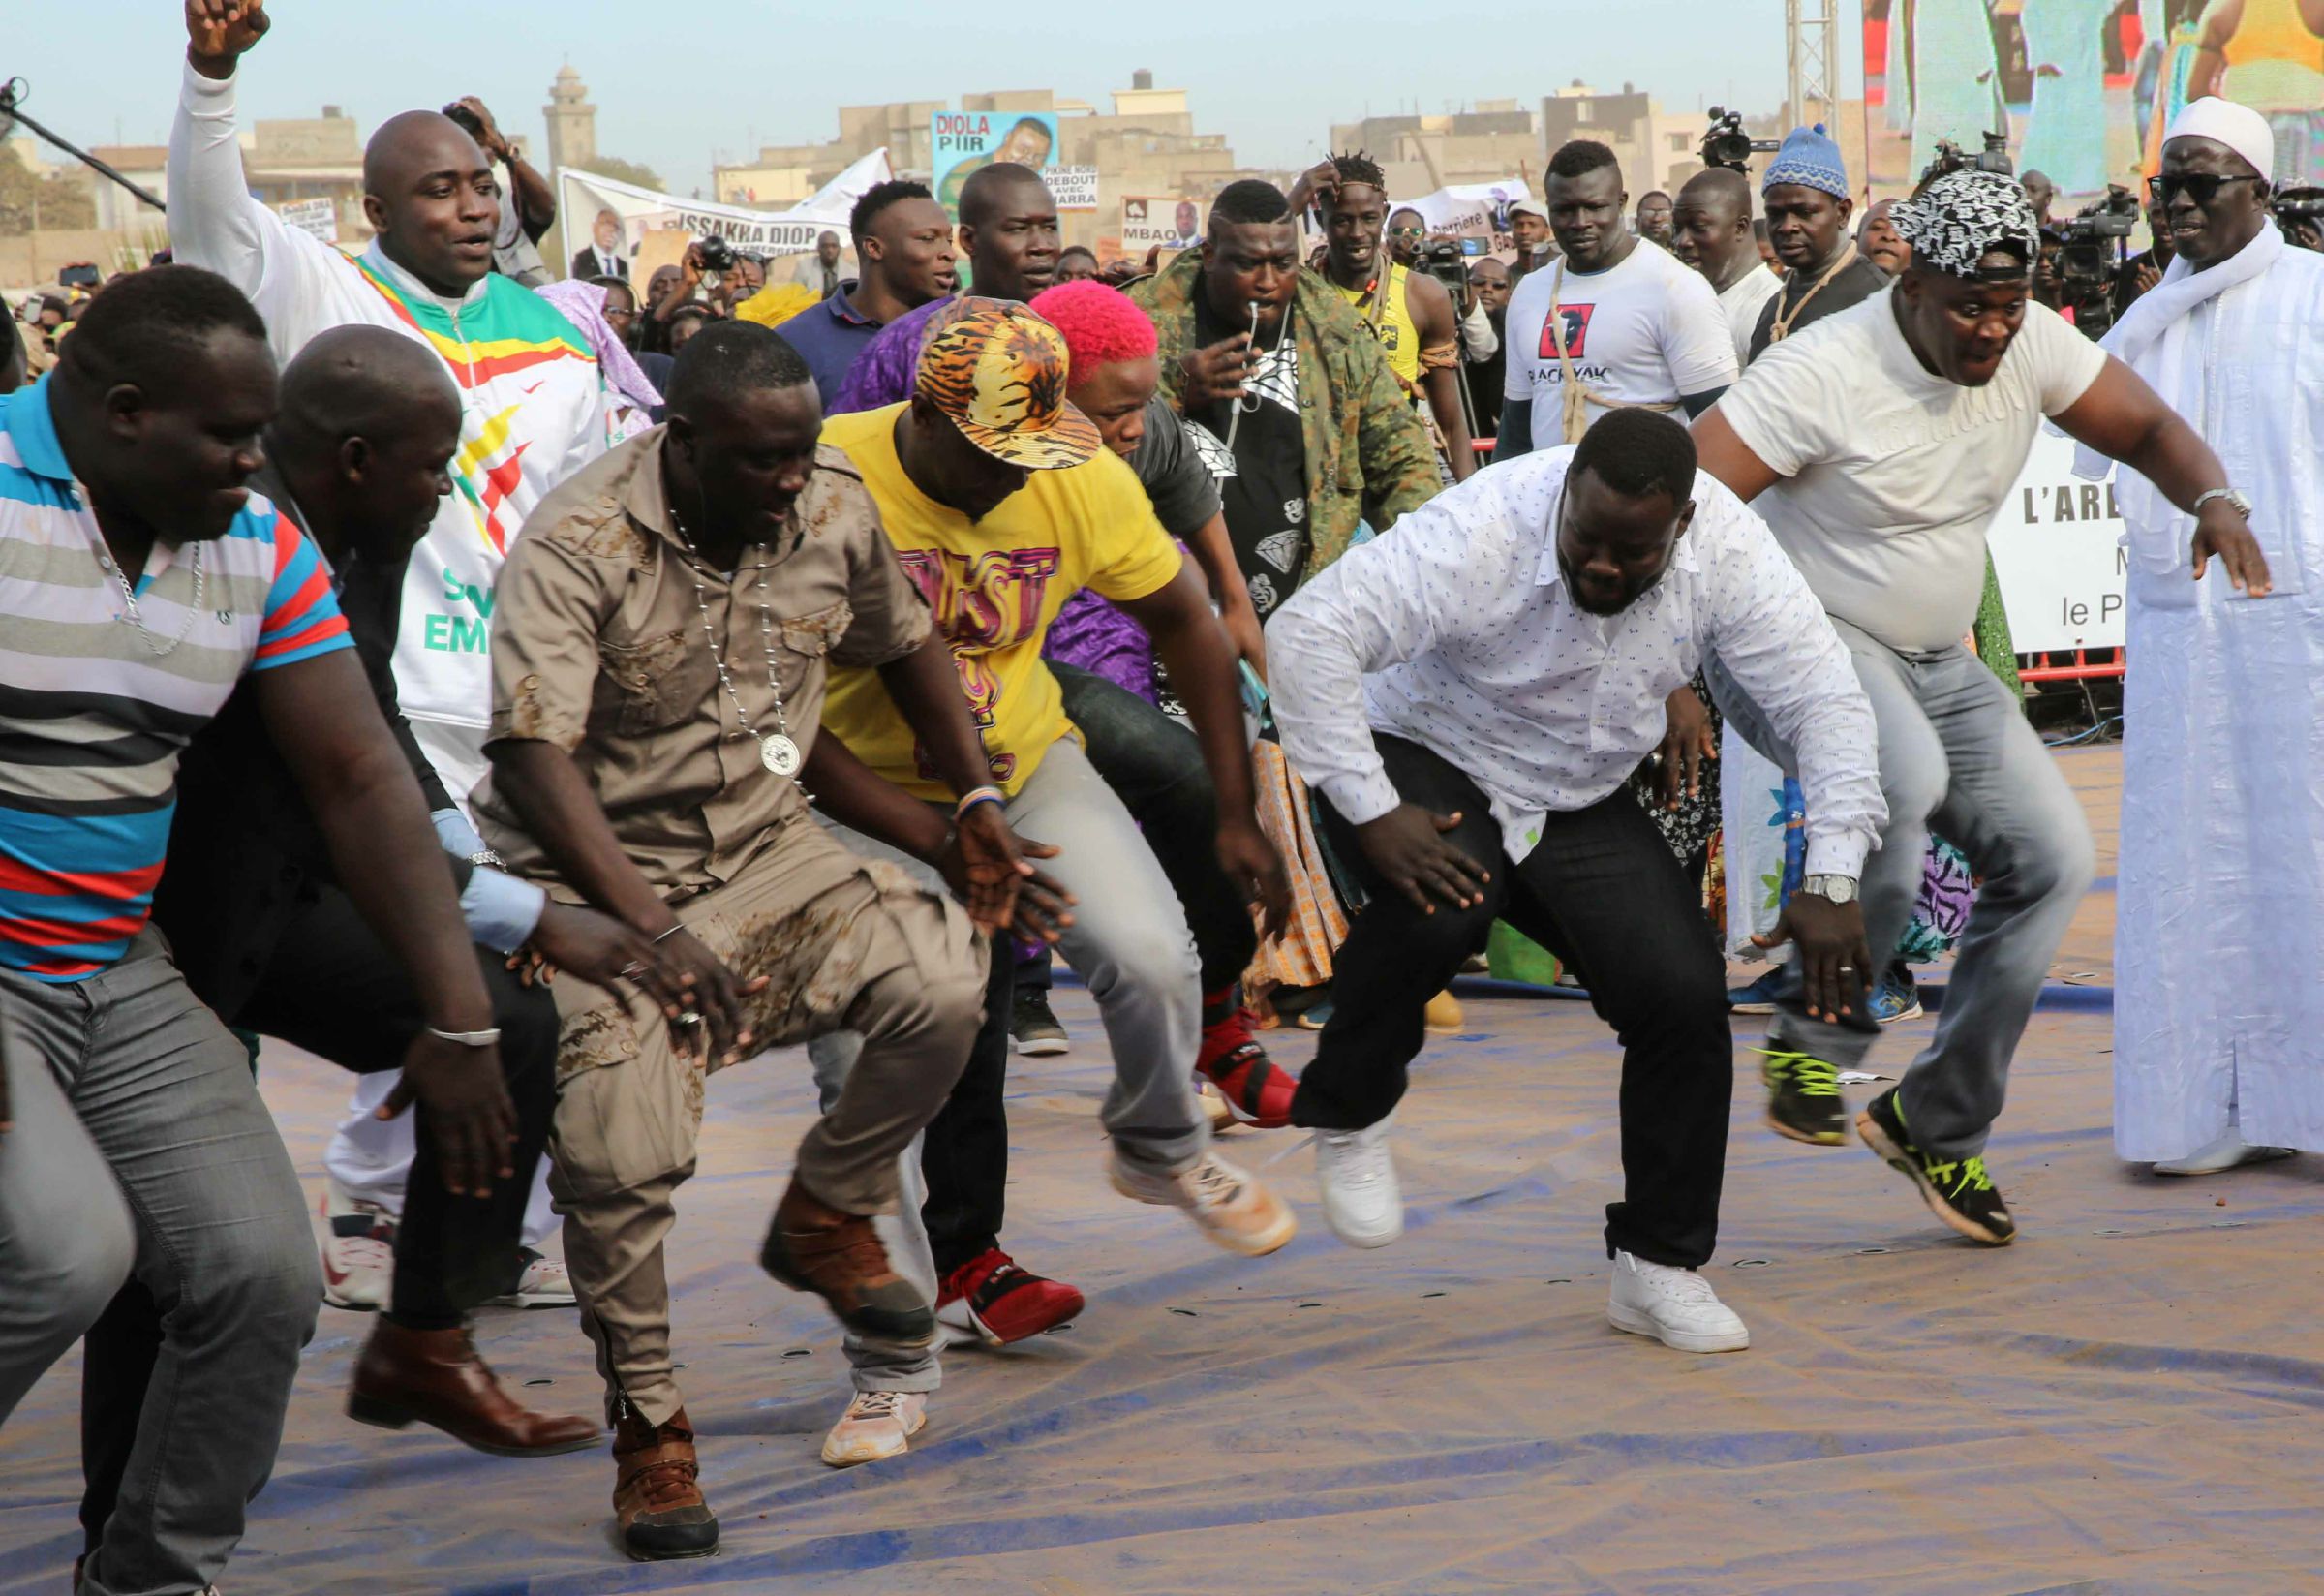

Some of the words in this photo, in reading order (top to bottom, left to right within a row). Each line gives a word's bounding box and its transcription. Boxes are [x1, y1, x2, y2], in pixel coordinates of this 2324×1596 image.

[936, 115, 990, 135] DIOLA
[939, 136, 984, 151] PIIR
[1045, 175, 1097, 186] DEBOUT
[1055, 185, 1084, 194] AVEC
[769, 225, 816, 245] DIOP
[1124, 228, 1177, 240] MBAO
[2063, 597, 2089, 626] le
[2101, 594, 2123, 623] P
[424, 613, 488, 655] EM
